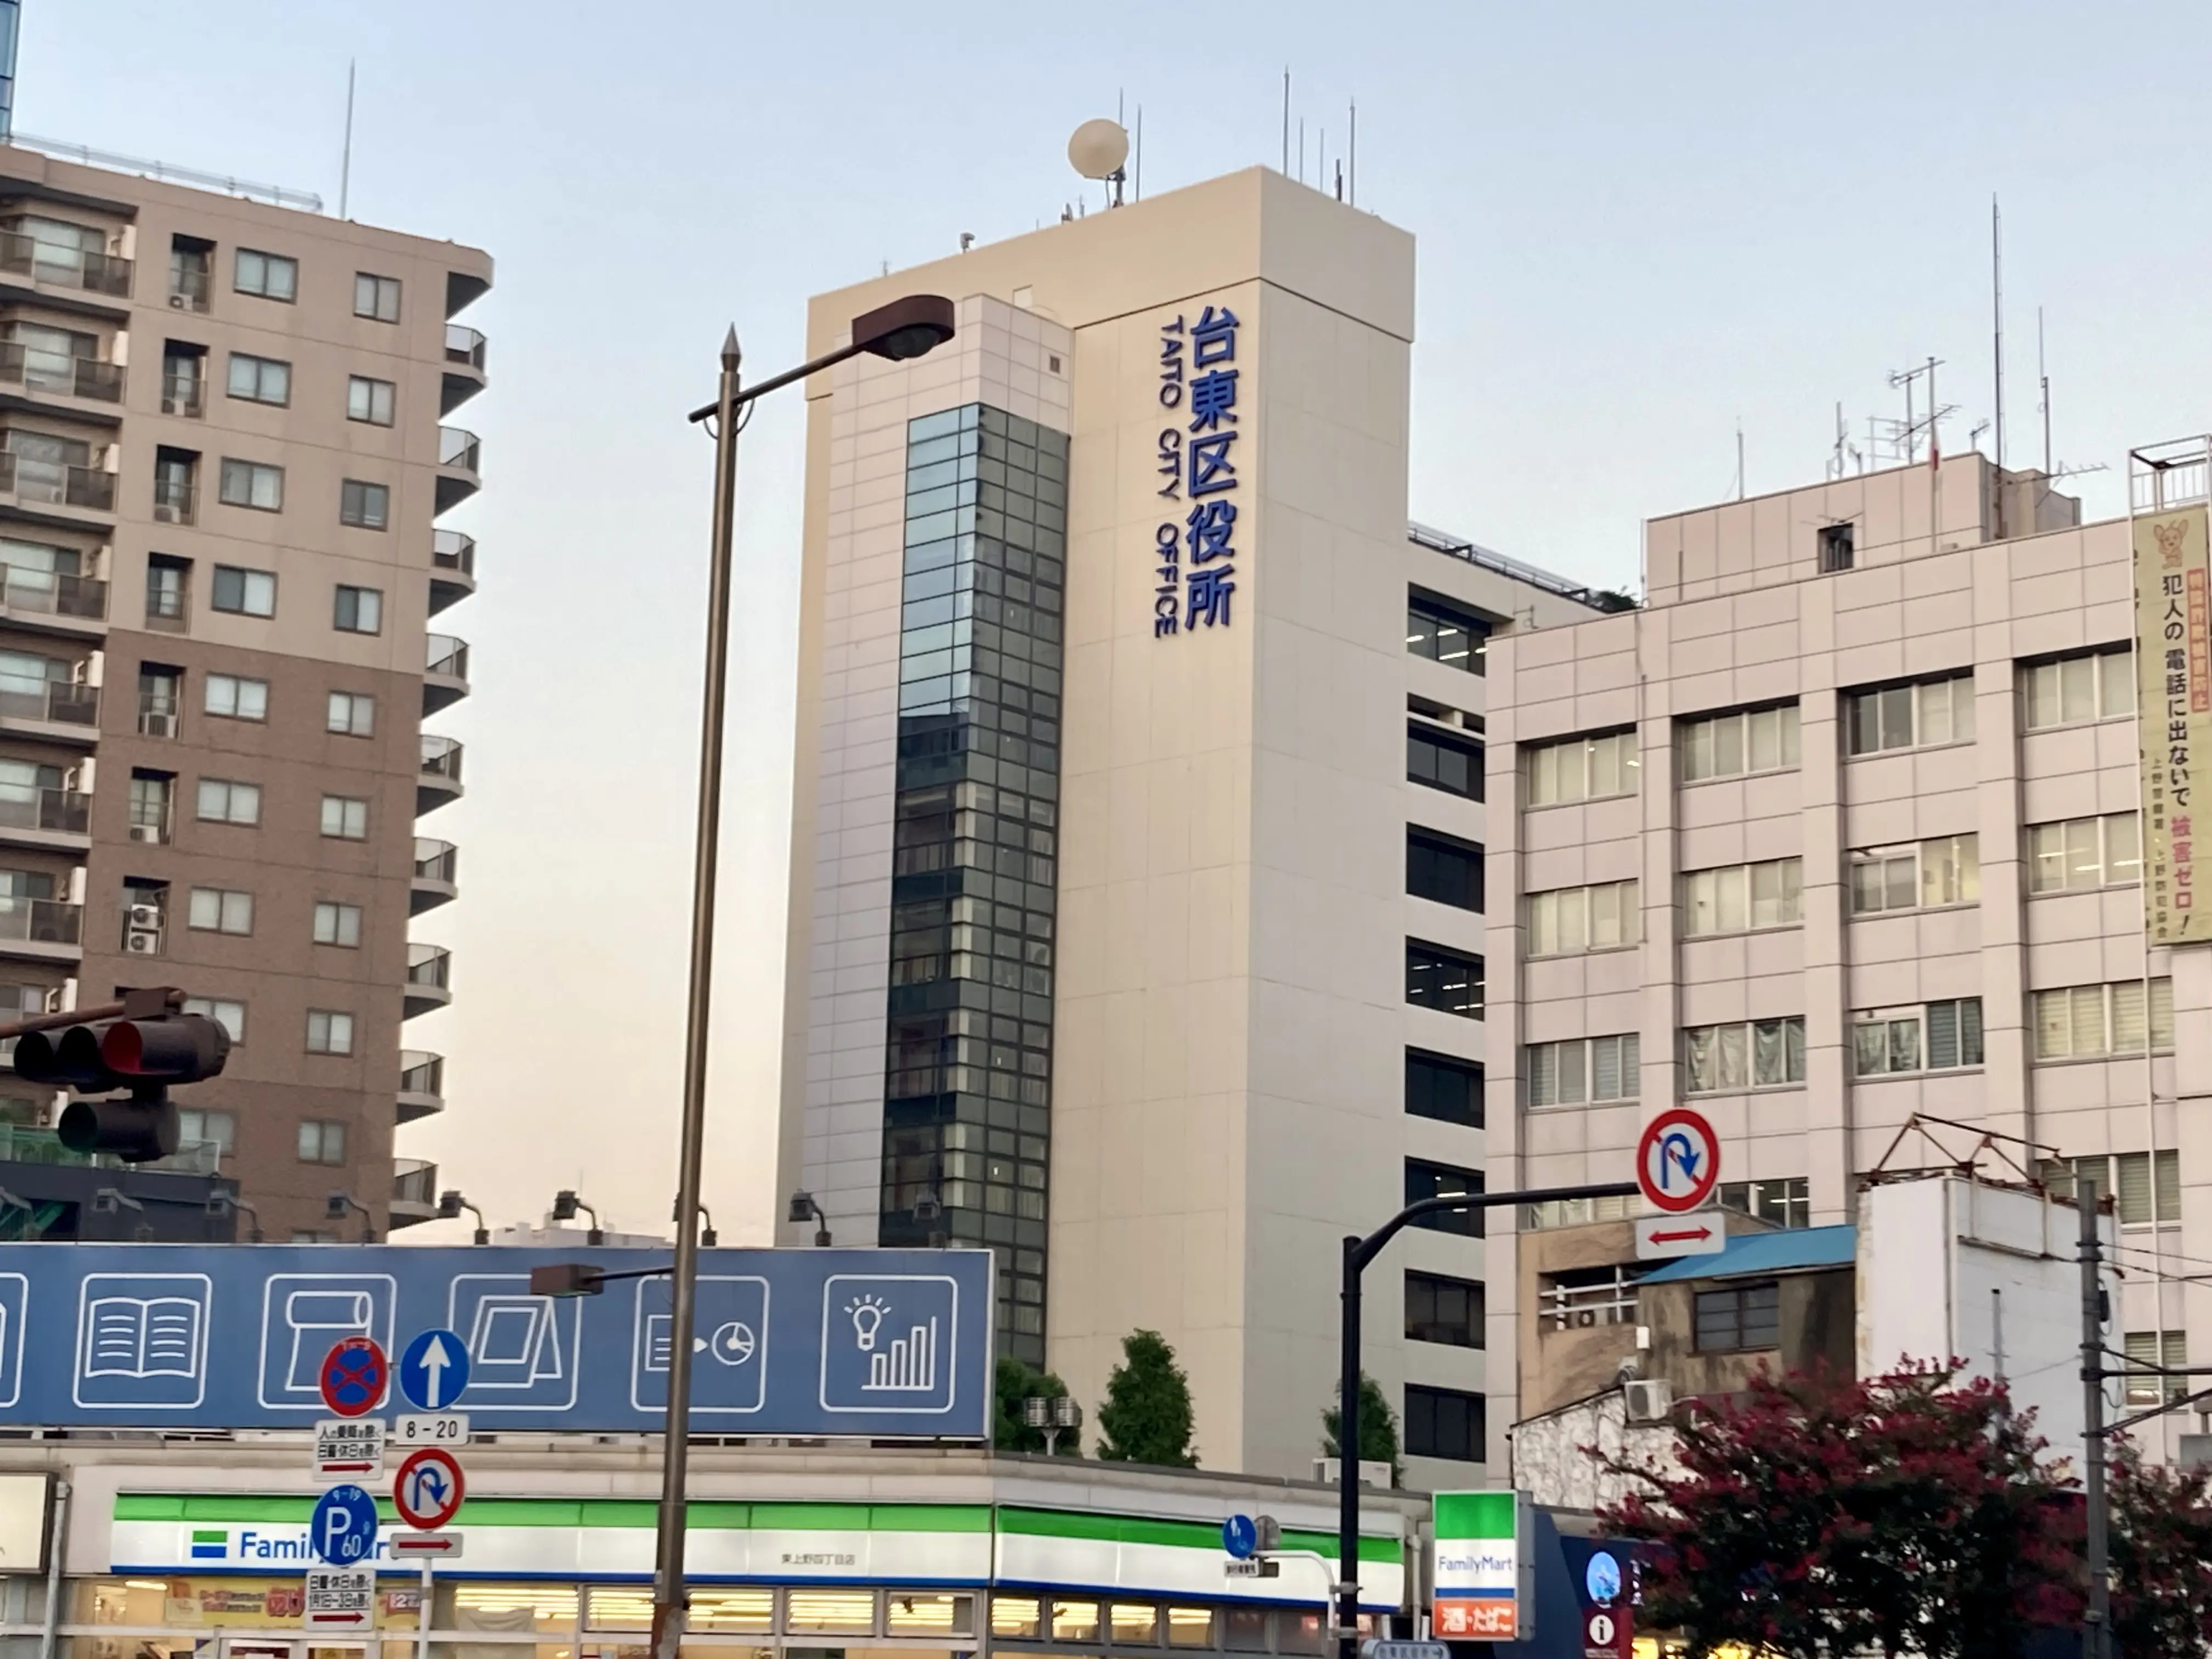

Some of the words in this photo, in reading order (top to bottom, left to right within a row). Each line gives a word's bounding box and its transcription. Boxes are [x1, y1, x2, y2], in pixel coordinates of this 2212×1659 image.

[1160, 314, 1184, 408] TAITO
[1158, 428, 1180, 501] CITY
[1184, 306, 1240, 631] 台東区役所
[1155, 523, 1179, 638] OFFICE
[406, 1420, 458, 1438] 8-20
[324, 1506, 352, 1557] P
[341, 1534, 362, 1557] 60
[1438, 1555, 1513, 1574] FamilyMart
[1442, 1606, 1513, 1633] 酒・たばこ
